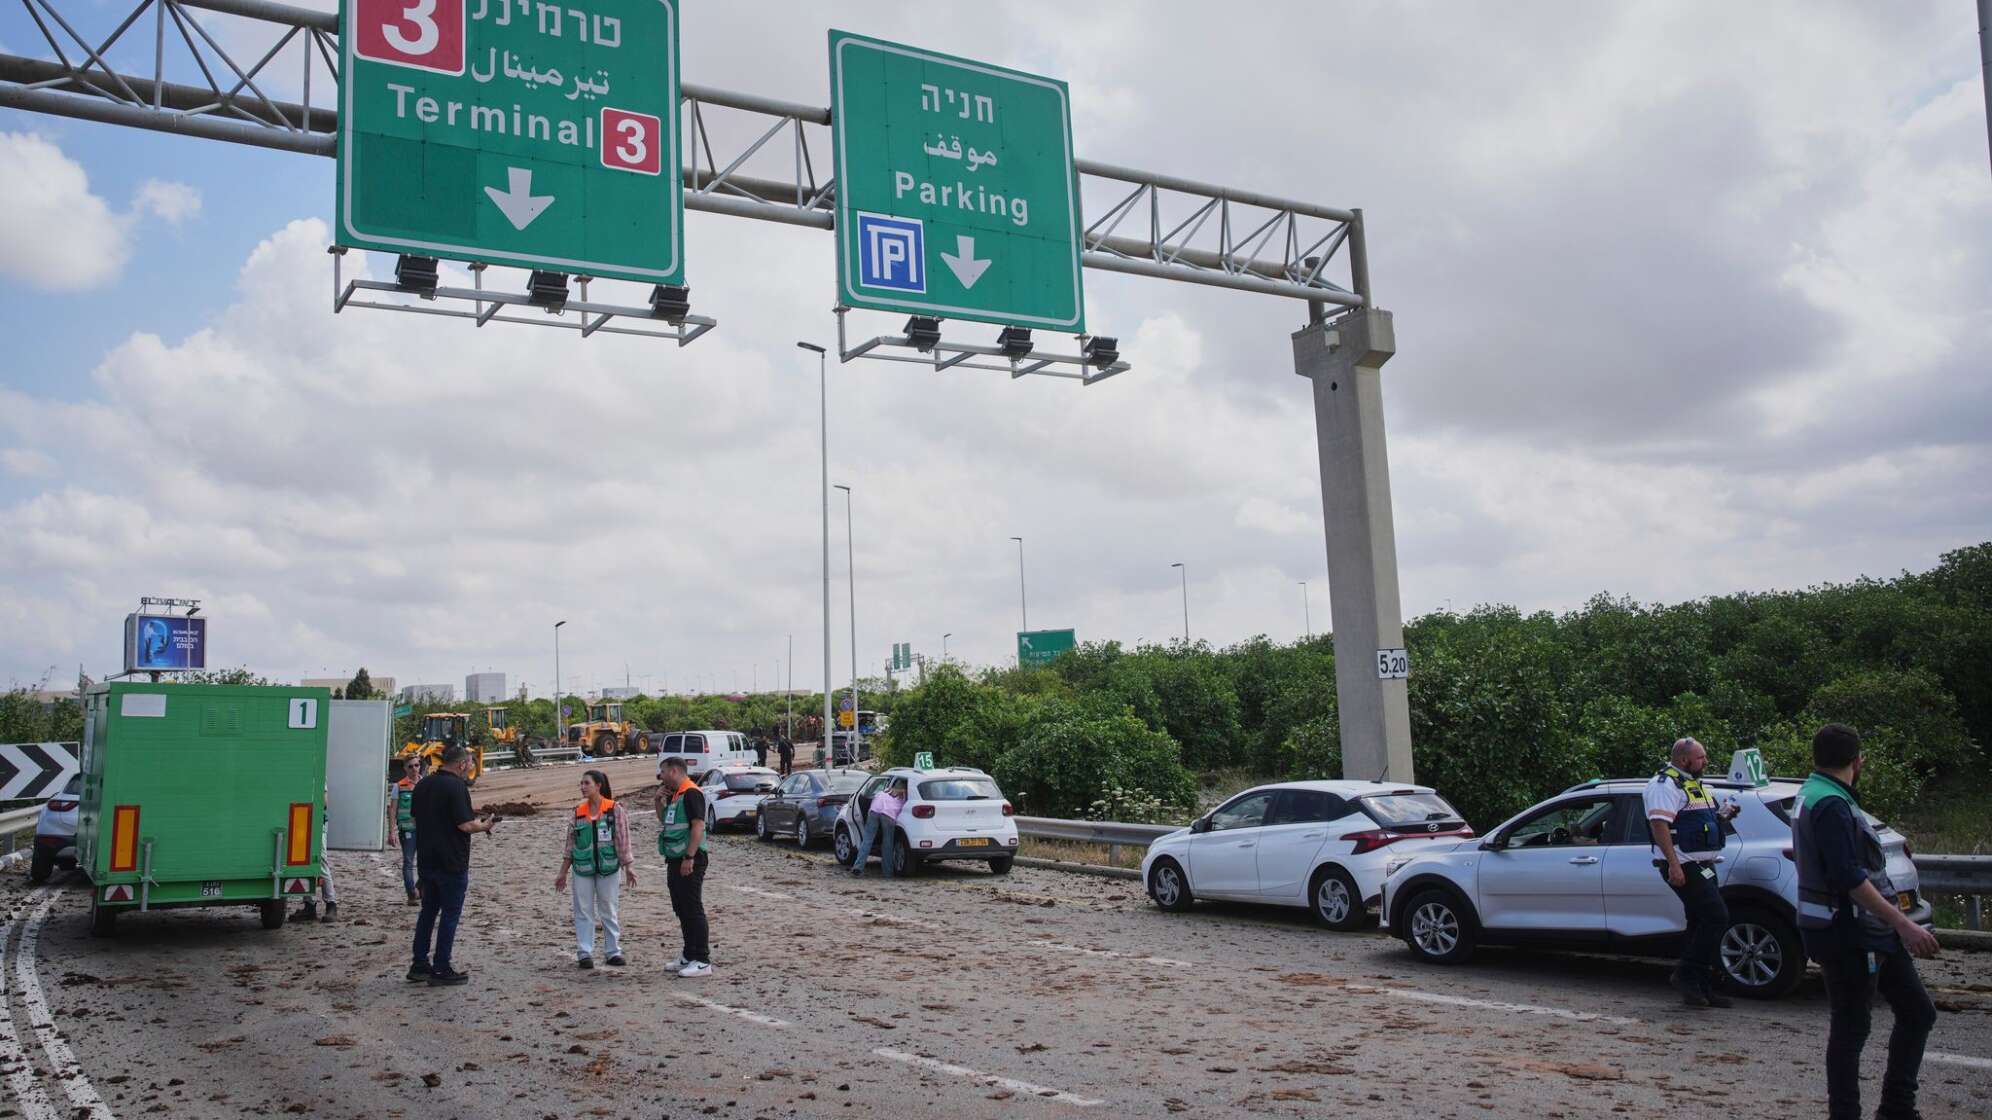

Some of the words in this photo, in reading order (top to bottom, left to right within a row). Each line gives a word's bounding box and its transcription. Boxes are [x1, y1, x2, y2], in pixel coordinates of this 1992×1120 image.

[381, 0, 440, 55] 3
[471, 47, 611, 100] تيرمينال
[921, 83, 994, 123] חניה
[387, 83, 594, 148] Terminal
[616, 118, 647, 164] 3
[924, 134, 997, 171] موقف
[895, 171, 1028, 226] Parking
[1380, 654, 1406, 673] 5.20
[300, 701, 307, 725] 1
[919, 754, 933, 768] 15
[1745, 754, 1768, 782] 12
